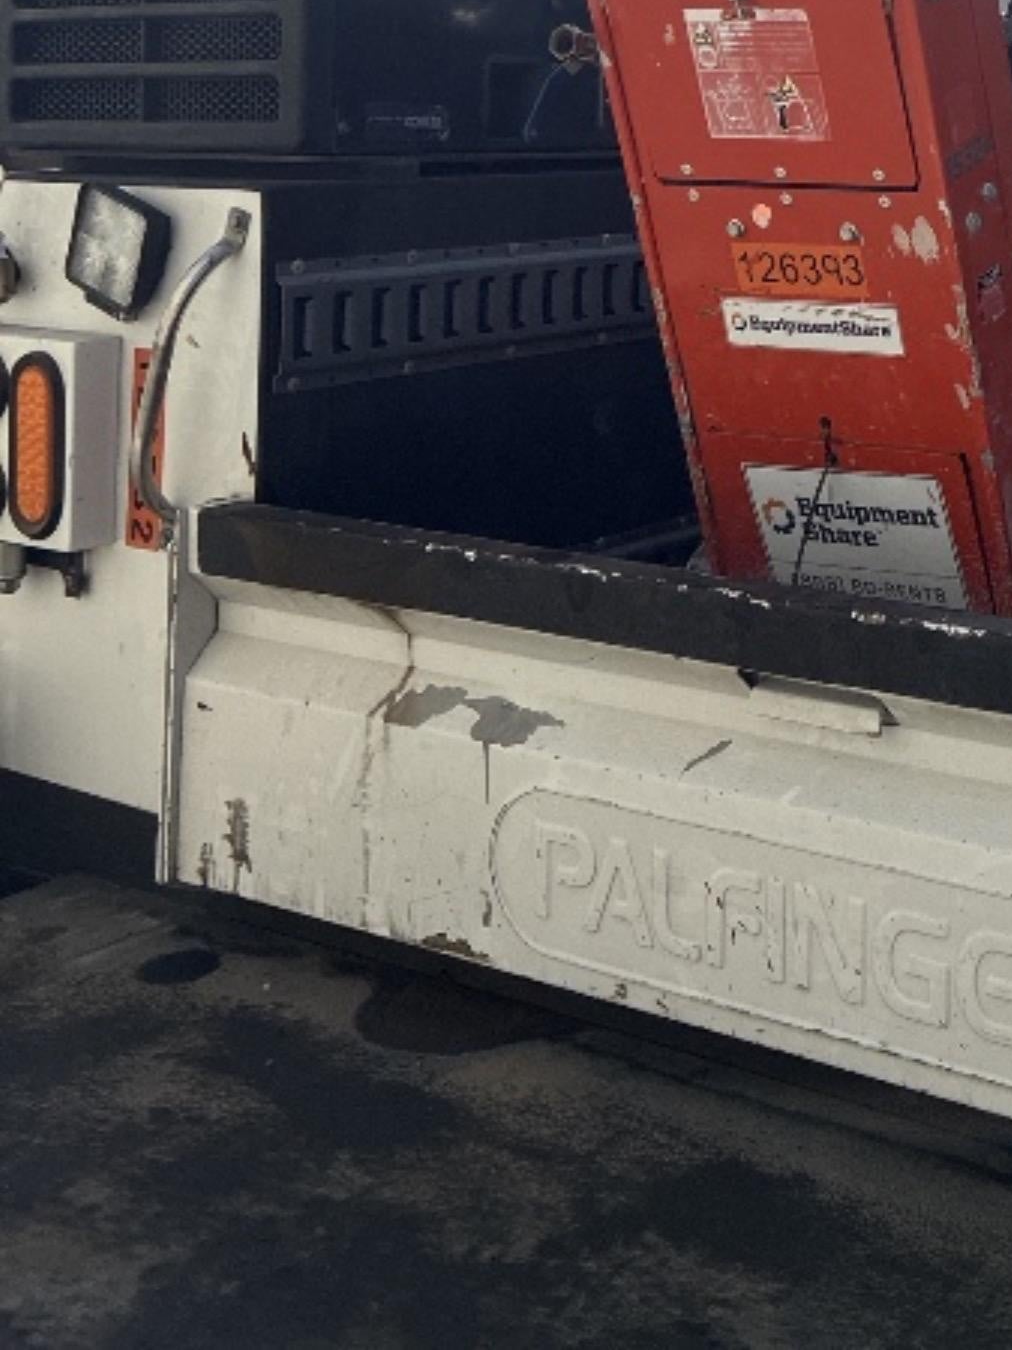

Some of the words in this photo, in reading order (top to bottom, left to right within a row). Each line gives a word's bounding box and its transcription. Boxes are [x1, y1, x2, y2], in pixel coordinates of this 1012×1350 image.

[738, 252, 864, 286] 126393
[795, 498, 940, 528] Equipment
[803, 520, 880, 547] Share
